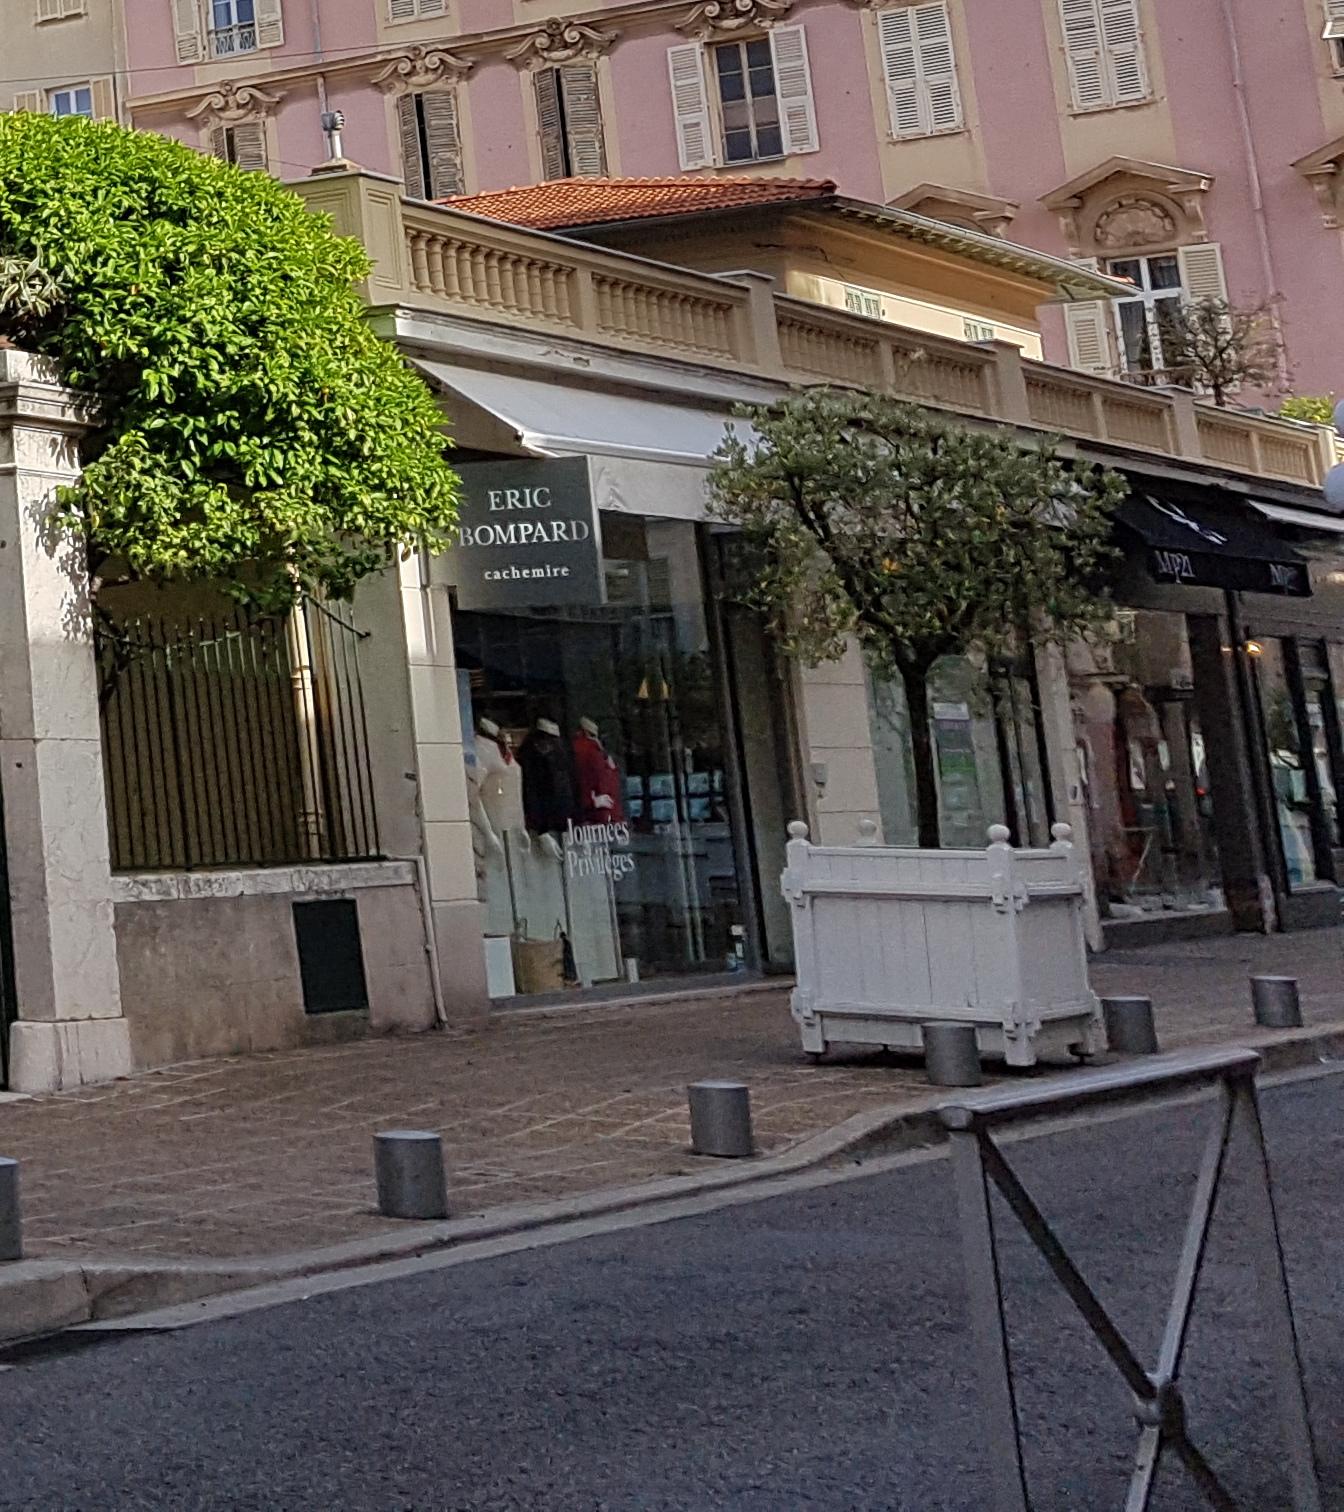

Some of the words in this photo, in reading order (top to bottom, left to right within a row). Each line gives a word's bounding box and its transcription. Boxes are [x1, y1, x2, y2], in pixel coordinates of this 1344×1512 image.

[488, 487, 552, 511] ERIC
[459, 520, 589, 547] BOMPARD
[484, 564, 570, 580] cachemire
[565, 815, 630, 846] Journées
[567, 846, 635, 882] Privilèges
